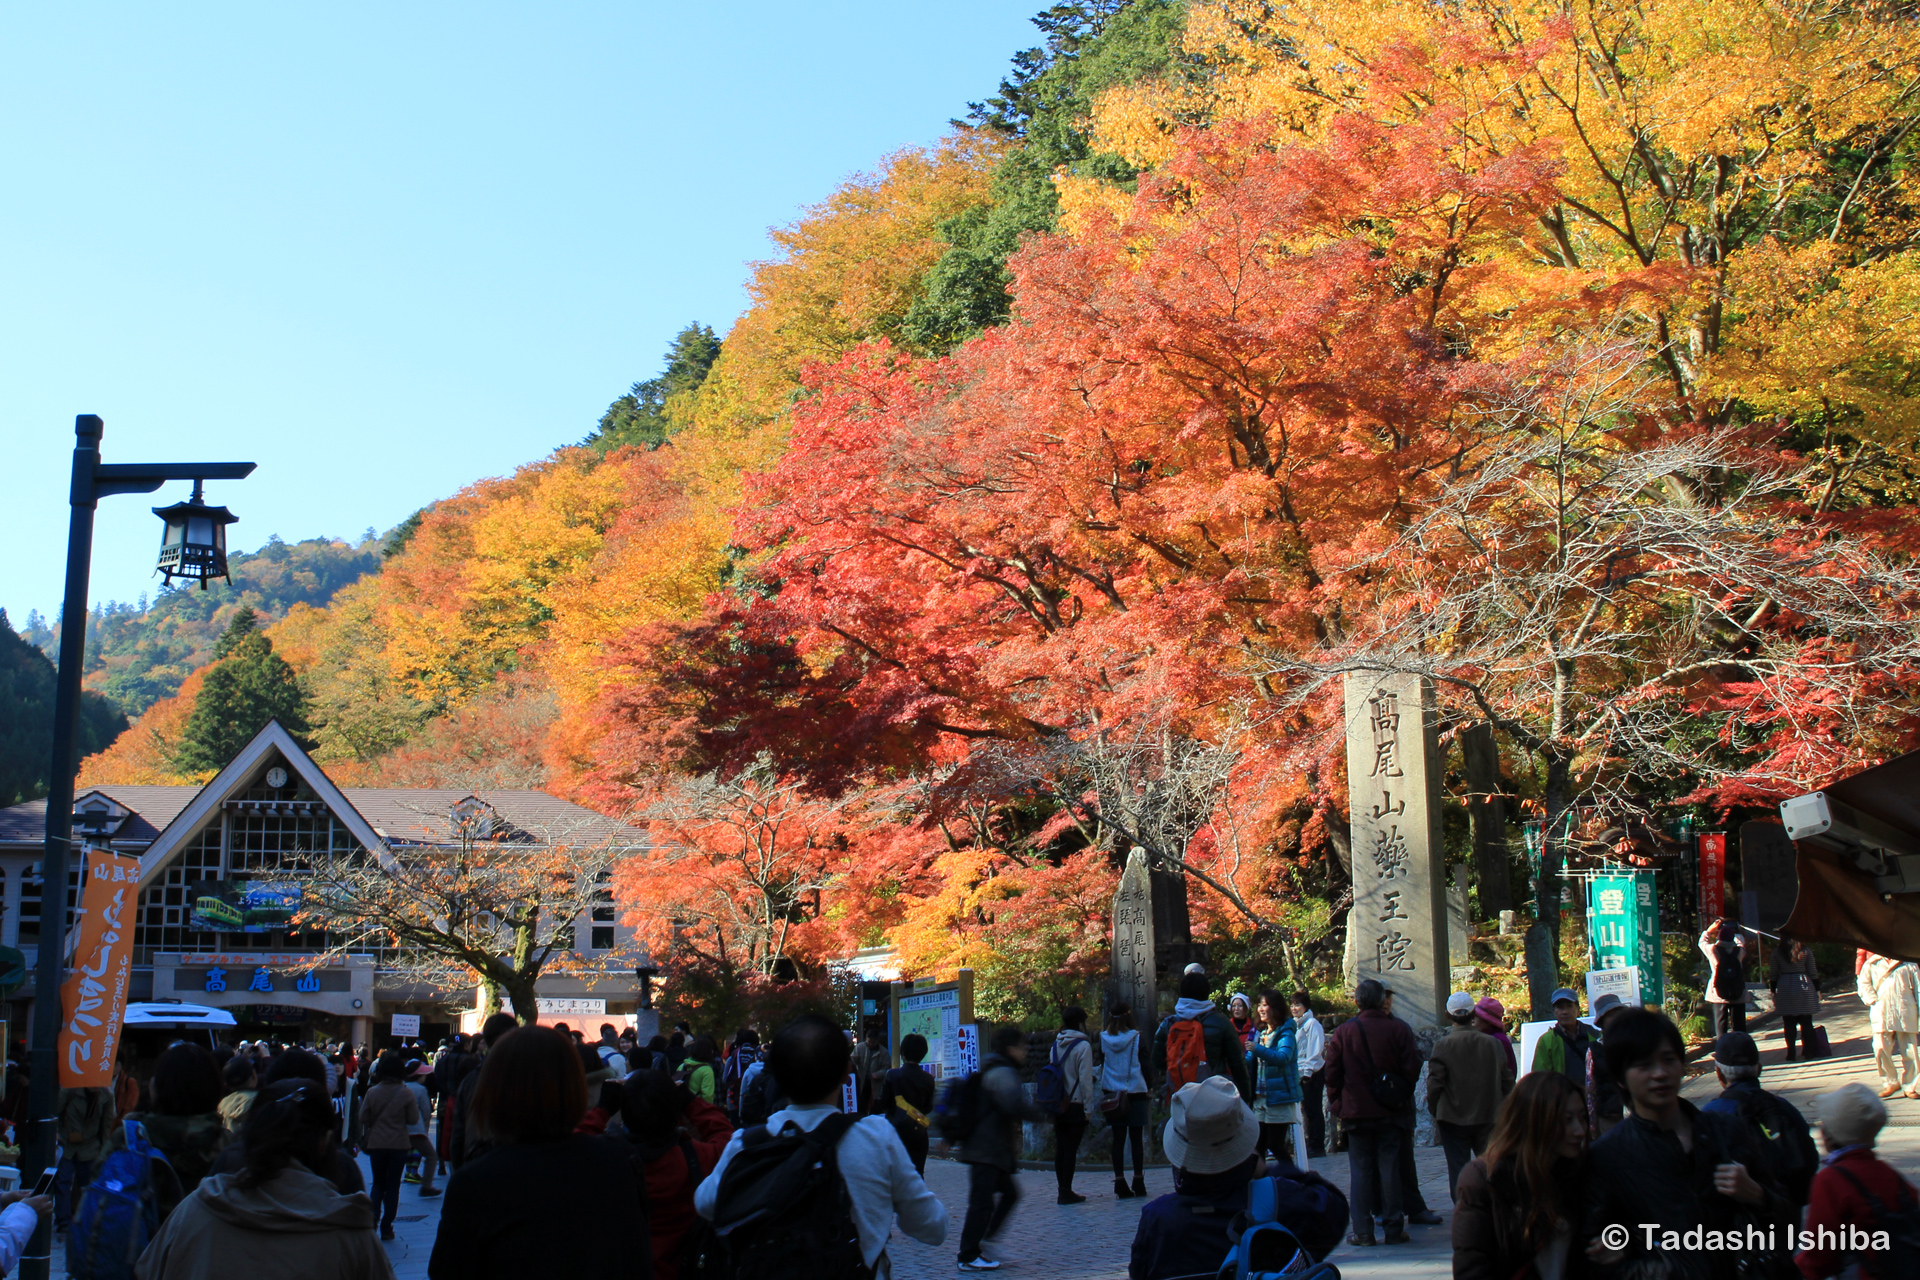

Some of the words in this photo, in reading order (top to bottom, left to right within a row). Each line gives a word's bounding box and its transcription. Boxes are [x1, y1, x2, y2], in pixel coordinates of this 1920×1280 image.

[183, 954, 255, 965] ケーブルカー
